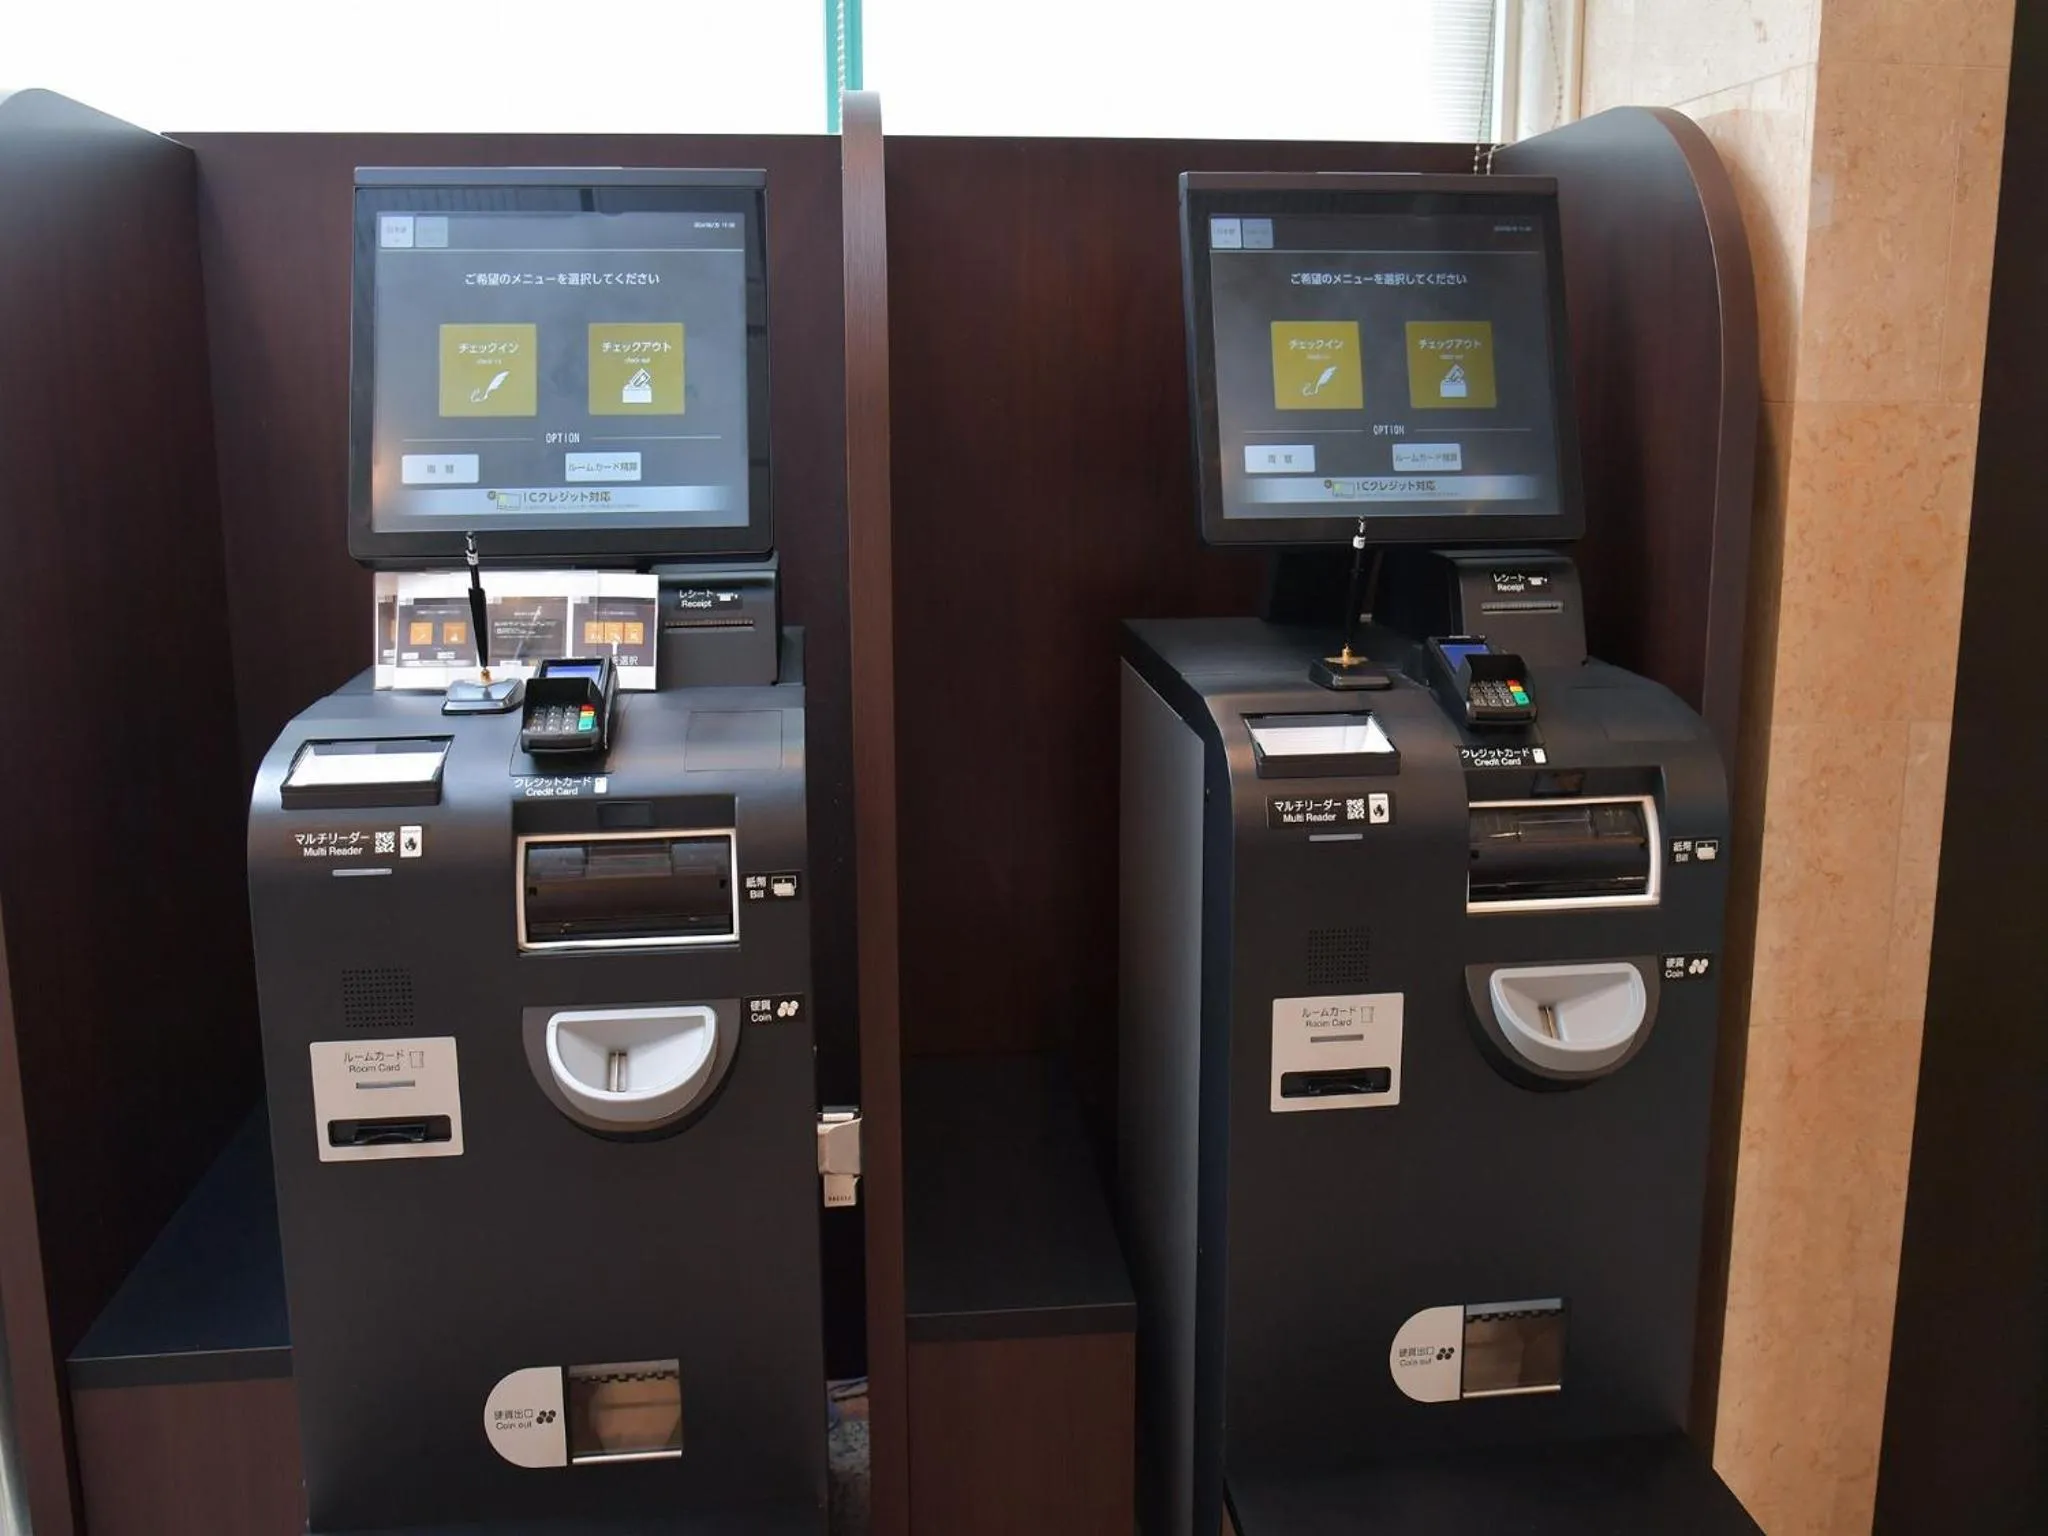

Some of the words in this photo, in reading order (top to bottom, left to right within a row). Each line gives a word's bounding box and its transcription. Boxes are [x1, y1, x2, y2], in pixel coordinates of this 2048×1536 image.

[464, 272, 660, 287] ご希望のメニューを選択してください
[1290, 272, 1467, 286] ご希望のメニューを選択してください
[458, 341, 520, 355] チェックイン
[602, 340, 672, 354] チェックアウト
[1288, 338, 1344, 351] チェックイン
[1418, 338, 1482, 351] チェックアウト
[1373, 424, 1405, 436] OPTION
[545, 431, 580, 444] OPTION
[1357, 480, 1436, 492] ICクレジット対応
[523, 491, 611, 503] ICクレジット対応
[1493, 573, 1526, 582] レシート
[679, 589, 714, 599] レシート
[681, 600, 712, 609] Receipt
[1461, 747, 1530, 759] クレジットカード
[514, 776, 592, 788] クレジットカード
[526, 788, 554, 796] Credit
[556, 787, 578, 795] Card
[1274, 799, 1342, 812] マルチリーダー
[1283, 814, 1304, 822] Multi
[1306, 813, 1337, 822] Reader
[294, 831, 370, 845] マルチリーダー
[303, 847, 327, 857] Multi
[329, 846, 363, 856] Reader
[1665, 969, 1684, 978] Coin
[750, 1012, 772, 1022] Coin
[1302, 1006, 1357, 1018] ルームカード
[1306, 1020, 1331, 1028] Room
[1332, 1018, 1353, 1027] Card
[344, 1049, 404, 1063] ルームカード
[349, 1064, 376, 1073] Room
[378, 1063, 401, 1072] Card
[496, 1422, 516, 1430] Coin
